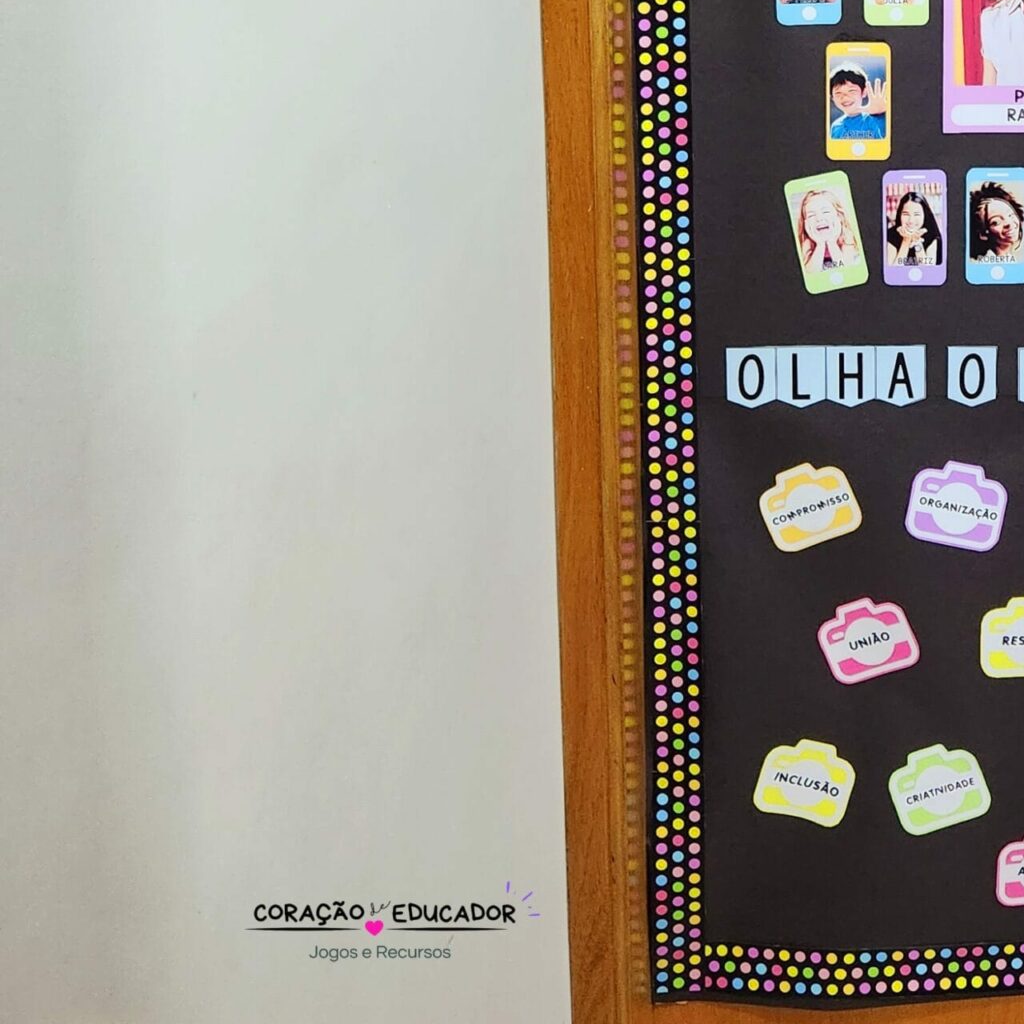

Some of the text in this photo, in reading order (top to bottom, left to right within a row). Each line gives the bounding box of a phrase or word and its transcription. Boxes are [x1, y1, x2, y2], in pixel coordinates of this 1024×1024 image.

[738, 351, 915, 402] OLHA
[959, 353, 987, 401] O
[772, 492, 850, 527] COMPROMISSO
[919, 496, 999, 523] ORGANIZAÇÃO
[849, 631, 891, 651] UNIÃO
[774, 771, 840, 798] INCLUSÃO
[906, 777, 975, 805] CRIATIVIDADE
